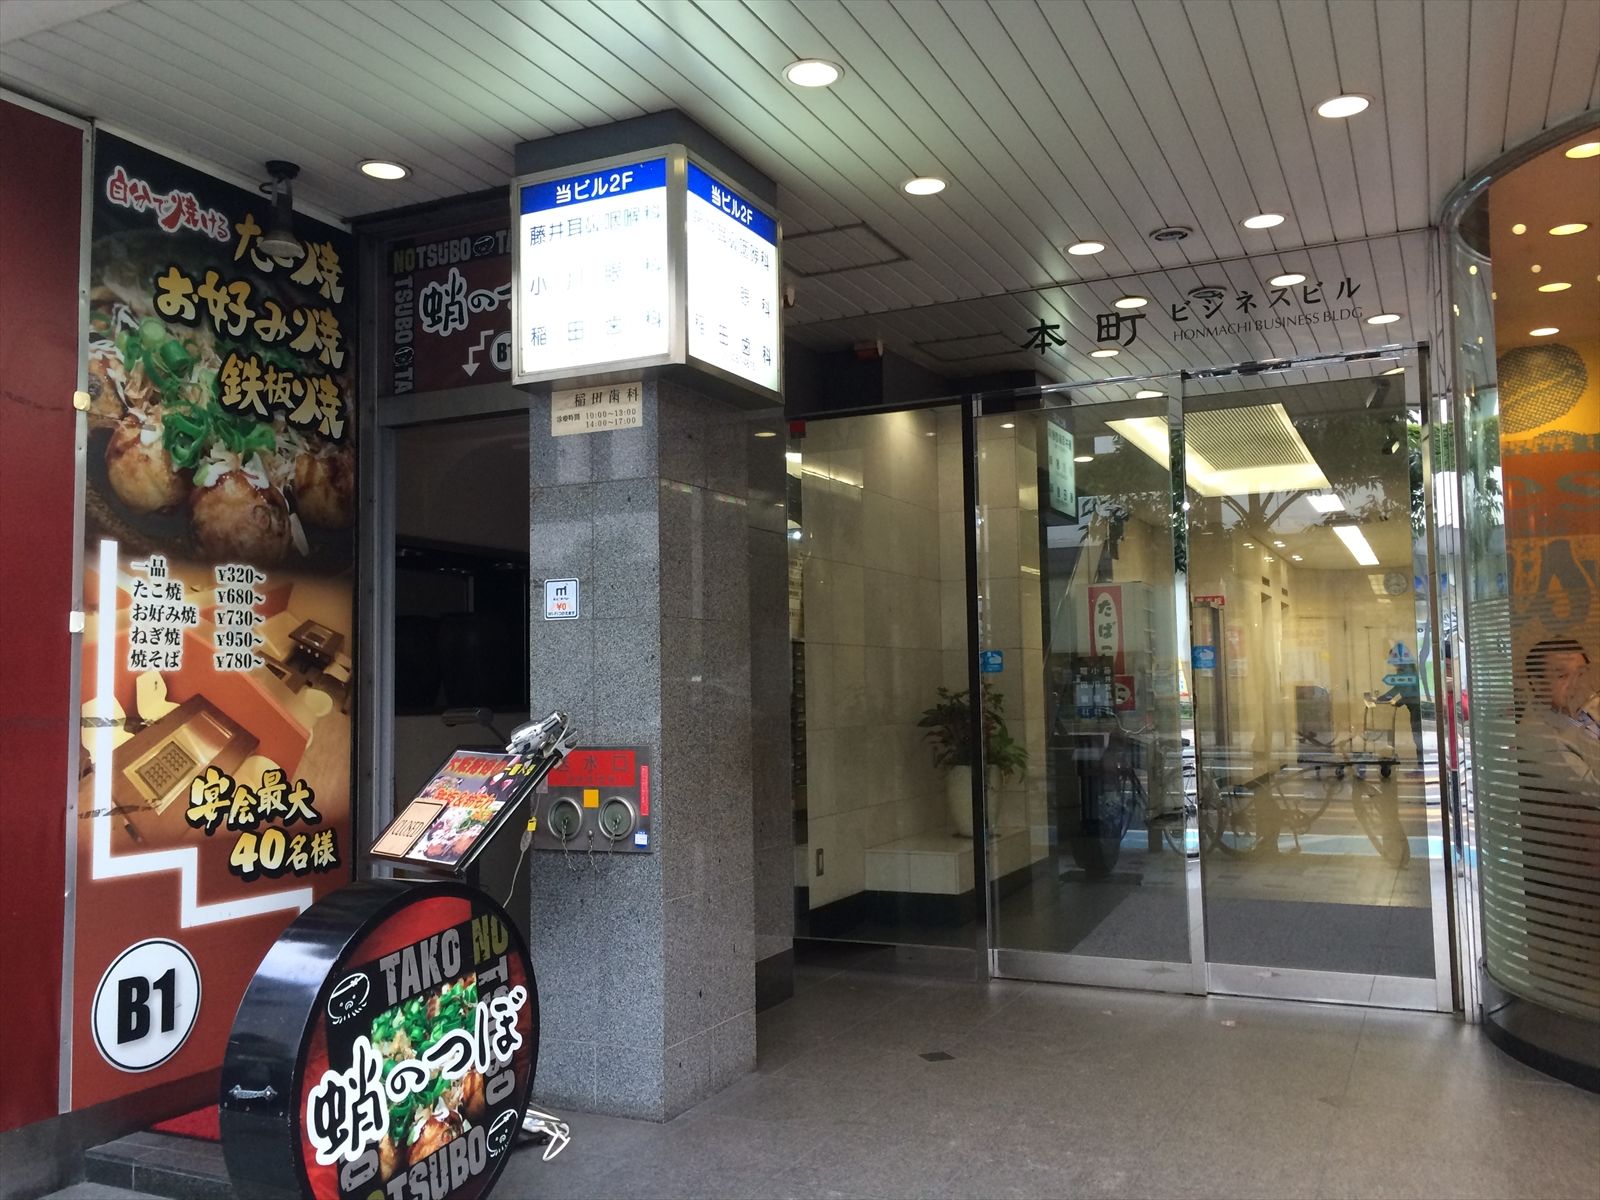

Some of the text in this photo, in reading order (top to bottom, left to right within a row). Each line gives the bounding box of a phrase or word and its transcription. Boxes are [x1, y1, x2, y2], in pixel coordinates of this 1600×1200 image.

[108, 166, 231, 241] 自分で焼ける
[555, 171, 634, 204] 当ビル2F
[711, 185, 753, 225] 当ビル2F
[234, 213, 344, 304] た焼
[156, 267, 345, 369] お好み焼
[1171, 277, 1363, 323] ビジネスビル
[1173, 306, 1364, 343] HONMACHI BUSINESS BLDG
[220, 352, 344, 440] 鉄板焼
[574, 386, 639, 408] 稲田歯科
[131, 558, 166, 578] 一品
[133, 580, 182, 601] たこ焼
[132, 603, 197, 625] お好み焼
[131, 626, 181, 647] ねぎ焼
[130, 649, 181, 669] 焼そば
[187, 768, 317, 829] 宴会最大
[230, 829, 336, 873] 40名様
[379, 928, 462, 1007] TAKO
[117, 967, 176, 1045] B1
